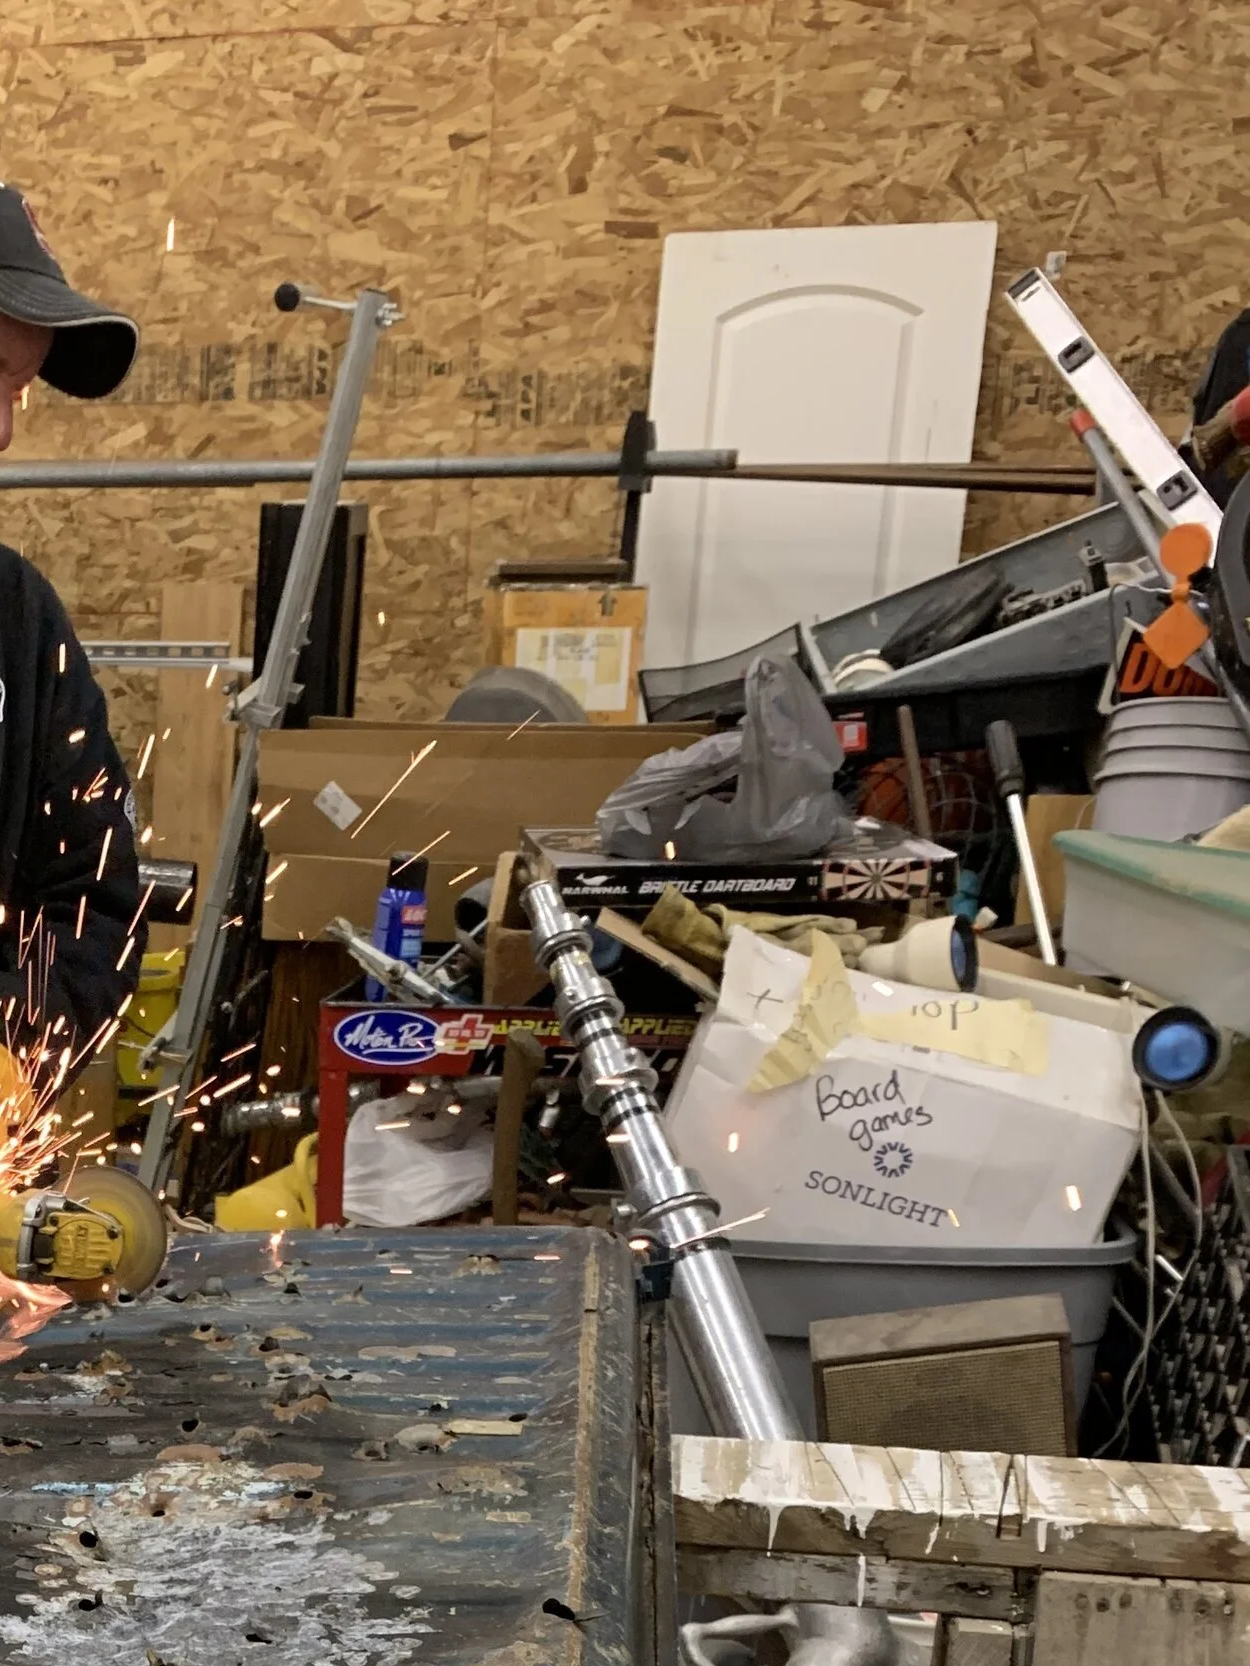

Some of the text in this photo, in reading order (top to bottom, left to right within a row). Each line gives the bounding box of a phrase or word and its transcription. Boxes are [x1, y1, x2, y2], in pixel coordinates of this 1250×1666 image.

[638, 878, 797, 895] BRITLE DARTBOARD
[815, 1069, 906, 1121] Board
[849, 1106, 933, 1152] games
[805, 1170, 949, 1229] SONLIGHT
